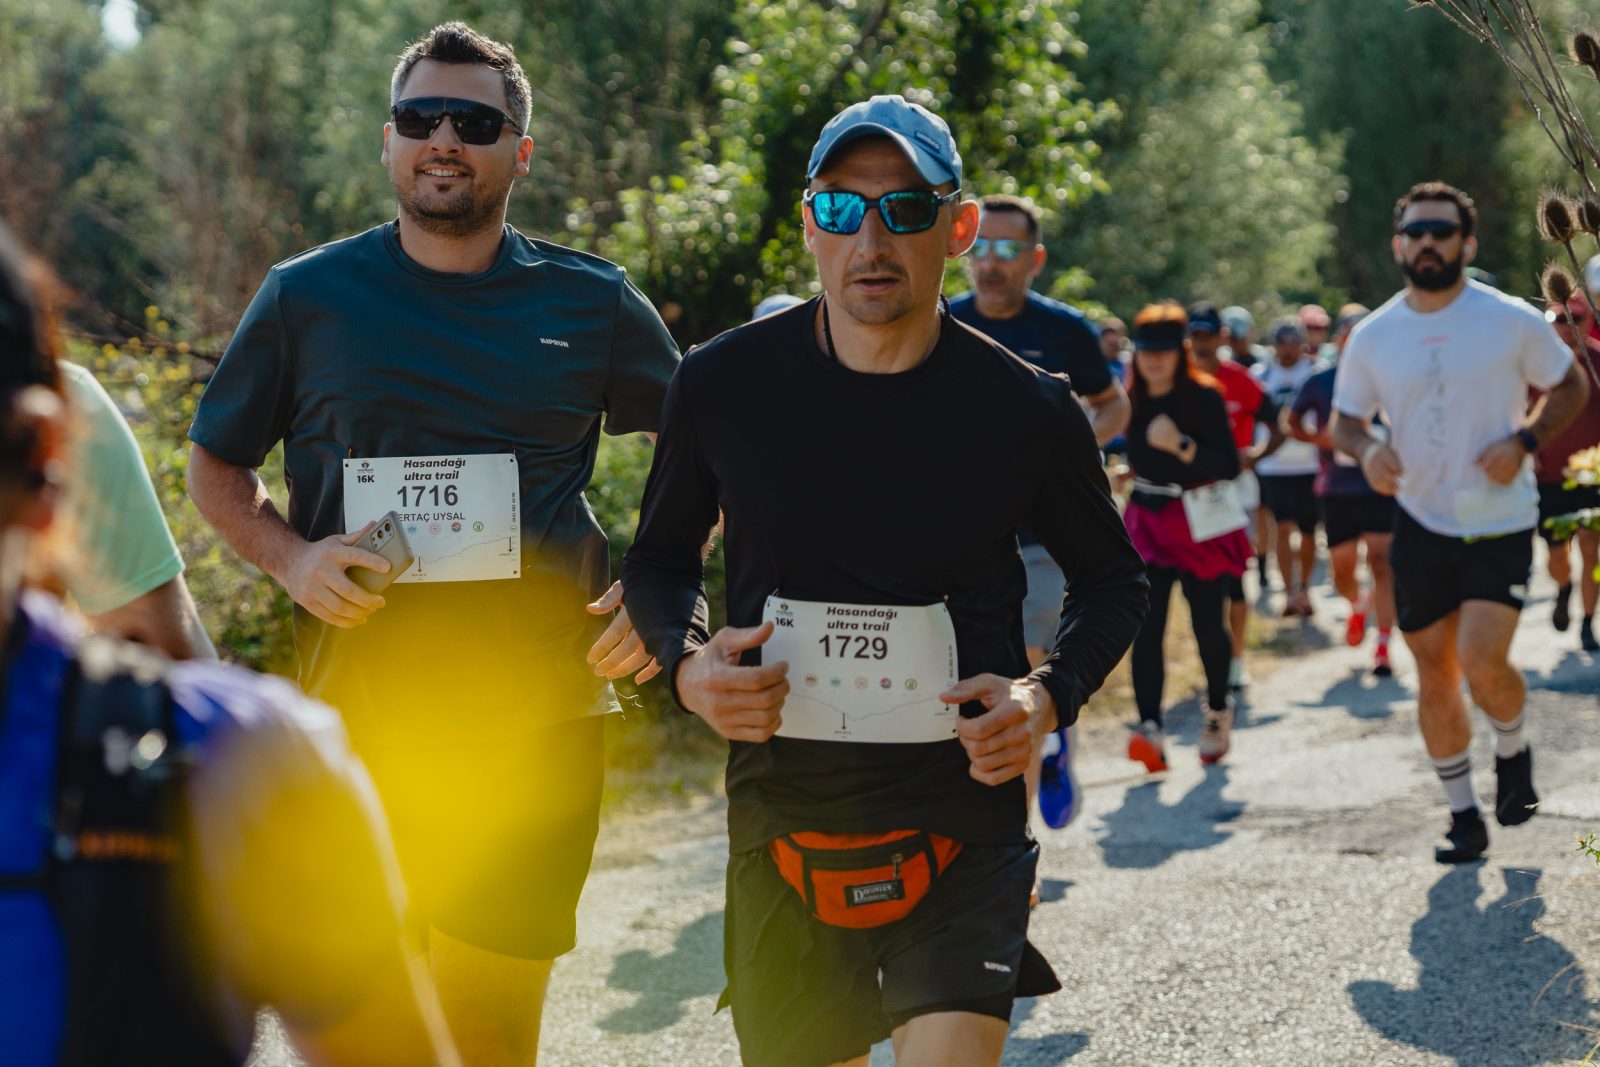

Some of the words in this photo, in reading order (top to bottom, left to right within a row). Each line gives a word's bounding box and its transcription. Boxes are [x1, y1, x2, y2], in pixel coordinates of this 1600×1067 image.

[403, 457, 466, 469] Hasandağı
[357, 474, 375, 484] 16K
[404, 471, 432, 481] ultra
[435, 470, 459, 481] trail
[397, 484, 459, 507] 1716
[433, 512, 465, 521] UYSAL
[826, 605, 898, 620] Hasandağı
[775, 617, 794, 628] 16K
[826, 621, 859, 630] ultra
[862, 621, 890, 632] trail
[818, 634, 888, 660] 1729
